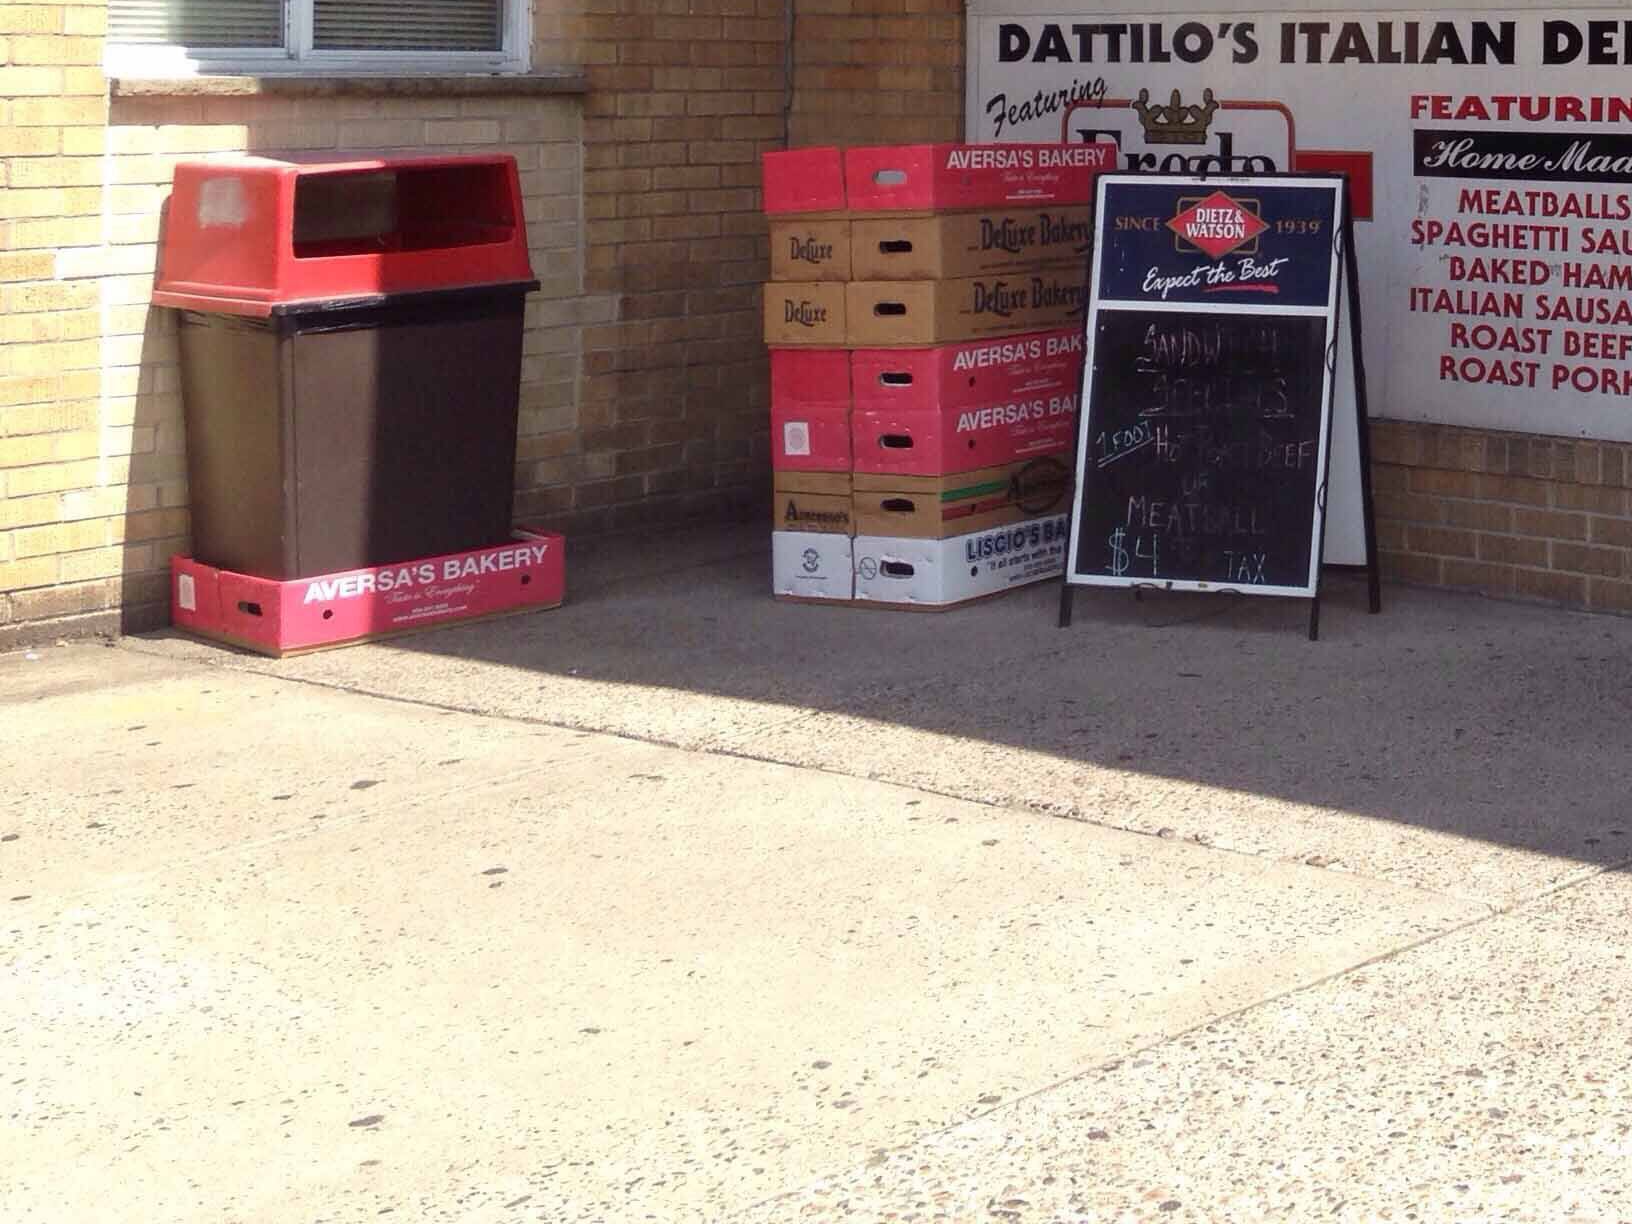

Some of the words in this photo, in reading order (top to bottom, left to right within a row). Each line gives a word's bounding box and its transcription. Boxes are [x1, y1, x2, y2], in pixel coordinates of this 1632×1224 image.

[998, 22, 1259, 64] DATTILO'S
[1279, 22, 1516, 65] ITALIAN
[985, 76, 1108, 138] Featuring
[947, 150, 1033, 169] AVERSA'S
[1038, 148, 1106, 167] BAKERY
[1423, 137, 1545, 171] Home
[1458, 189, 1632, 221] MEATBALLS
[980, 217, 1035, 253] DeLuxe
[1115, 216, 1160, 232] SINCE
[1276, 219, 1321, 235] 1939
[1185, 223, 1246, 239] WATSON
[1411, 219, 1569, 252] SPAGHETTI
[790, 236, 833, 264] DeLuxe
[1142, 266, 1210, 300] Expect
[1206, 261, 1236, 284] the
[1237, 257, 1289, 281] Best
[1449, 256, 1550, 286] BAKED
[784, 299, 827, 327] DeLuxe
[1409, 287, 1523, 319] ITALIAN
[953, 340, 1040, 371] AVERSA'S
[1046, 334, 1082, 356] BAK
[1451, 322, 1552, 354] ROAST
[1440, 355, 1540, 388] ROAST
[957, 400, 1044, 432] AVERSA'S
[965, 522, 1040, 562] LISCIO'S
[304, 564, 437, 605] AVERSA'S
[444, 545, 548, 580] BAKERY
